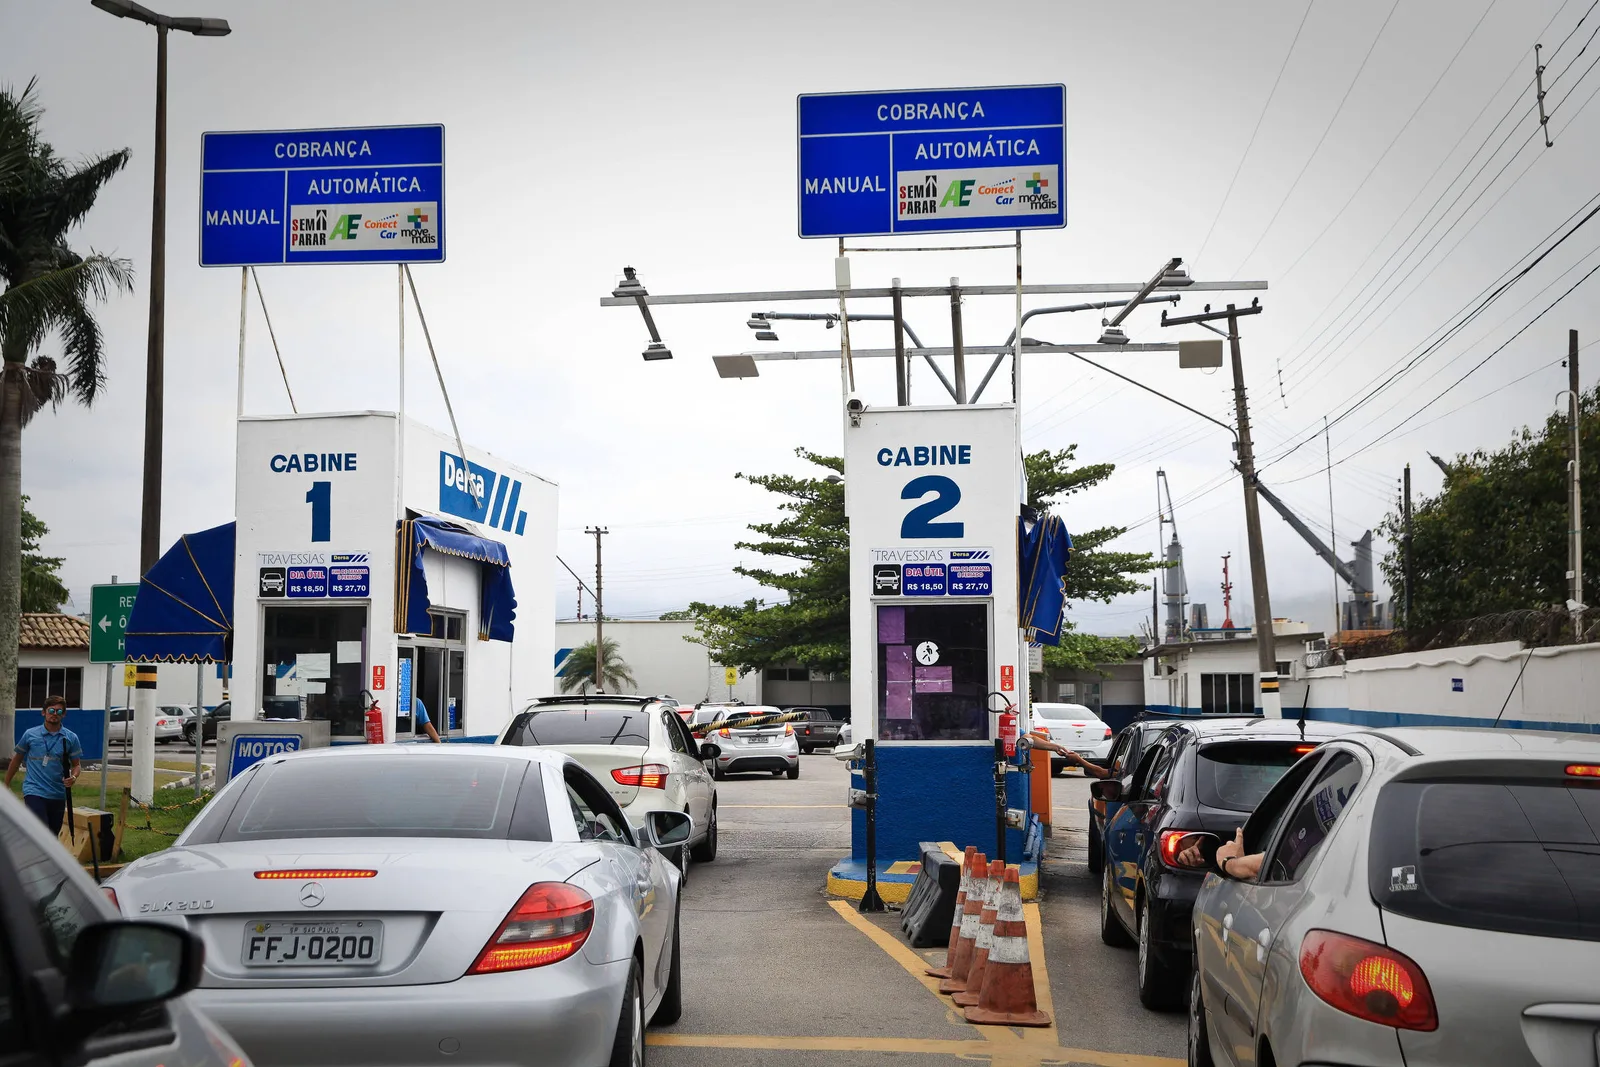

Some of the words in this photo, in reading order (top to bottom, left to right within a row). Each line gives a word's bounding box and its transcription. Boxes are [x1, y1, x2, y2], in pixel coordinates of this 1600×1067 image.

[877, 101, 985, 121] COBRANÇA
[274, 140, 372, 158] COBRANÇA
[915, 134, 1040, 160] AUTOMÁTICA
[308, 172, 422, 195] AUTOMÁTICA
[805, 175, 886, 195] MANUAL
[978, 184, 1014, 195] Conect
[900, 186, 924, 199] SEM
[1018, 194, 1049, 204] move
[996, 195, 1014, 205] Car
[1030, 200, 1057, 210] mais
[900, 200, 936, 215] PARAR
[206, 209, 280, 226] MANUAL
[292, 218, 316, 232] SEM
[364, 219, 398, 230] Conect
[292, 232, 326, 246] PARAR
[380, 230, 397, 239] Car
[401, 228, 429, 238] move
[411, 233, 436, 244] mais
[877, 445, 971, 466] CABINE
[270, 453, 357, 473] CABINE
[306, 482, 331, 542] 1
[900, 475, 964, 539] 2
[262, 554, 324, 564] TRAVESSIAS
[875, 550, 943, 561] TRAVESSIAS
[290, 571, 305, 579] DIA
[307, 569, 325, 579] ÚTIL
[906, 568, 922, 576] DIA
[924, 566, 944, 576] ÚTIL
[238, 742, 295, 758] MOTOS
[140, 900, 174, 912] SLK
[176, 900, 214, 911] 200
